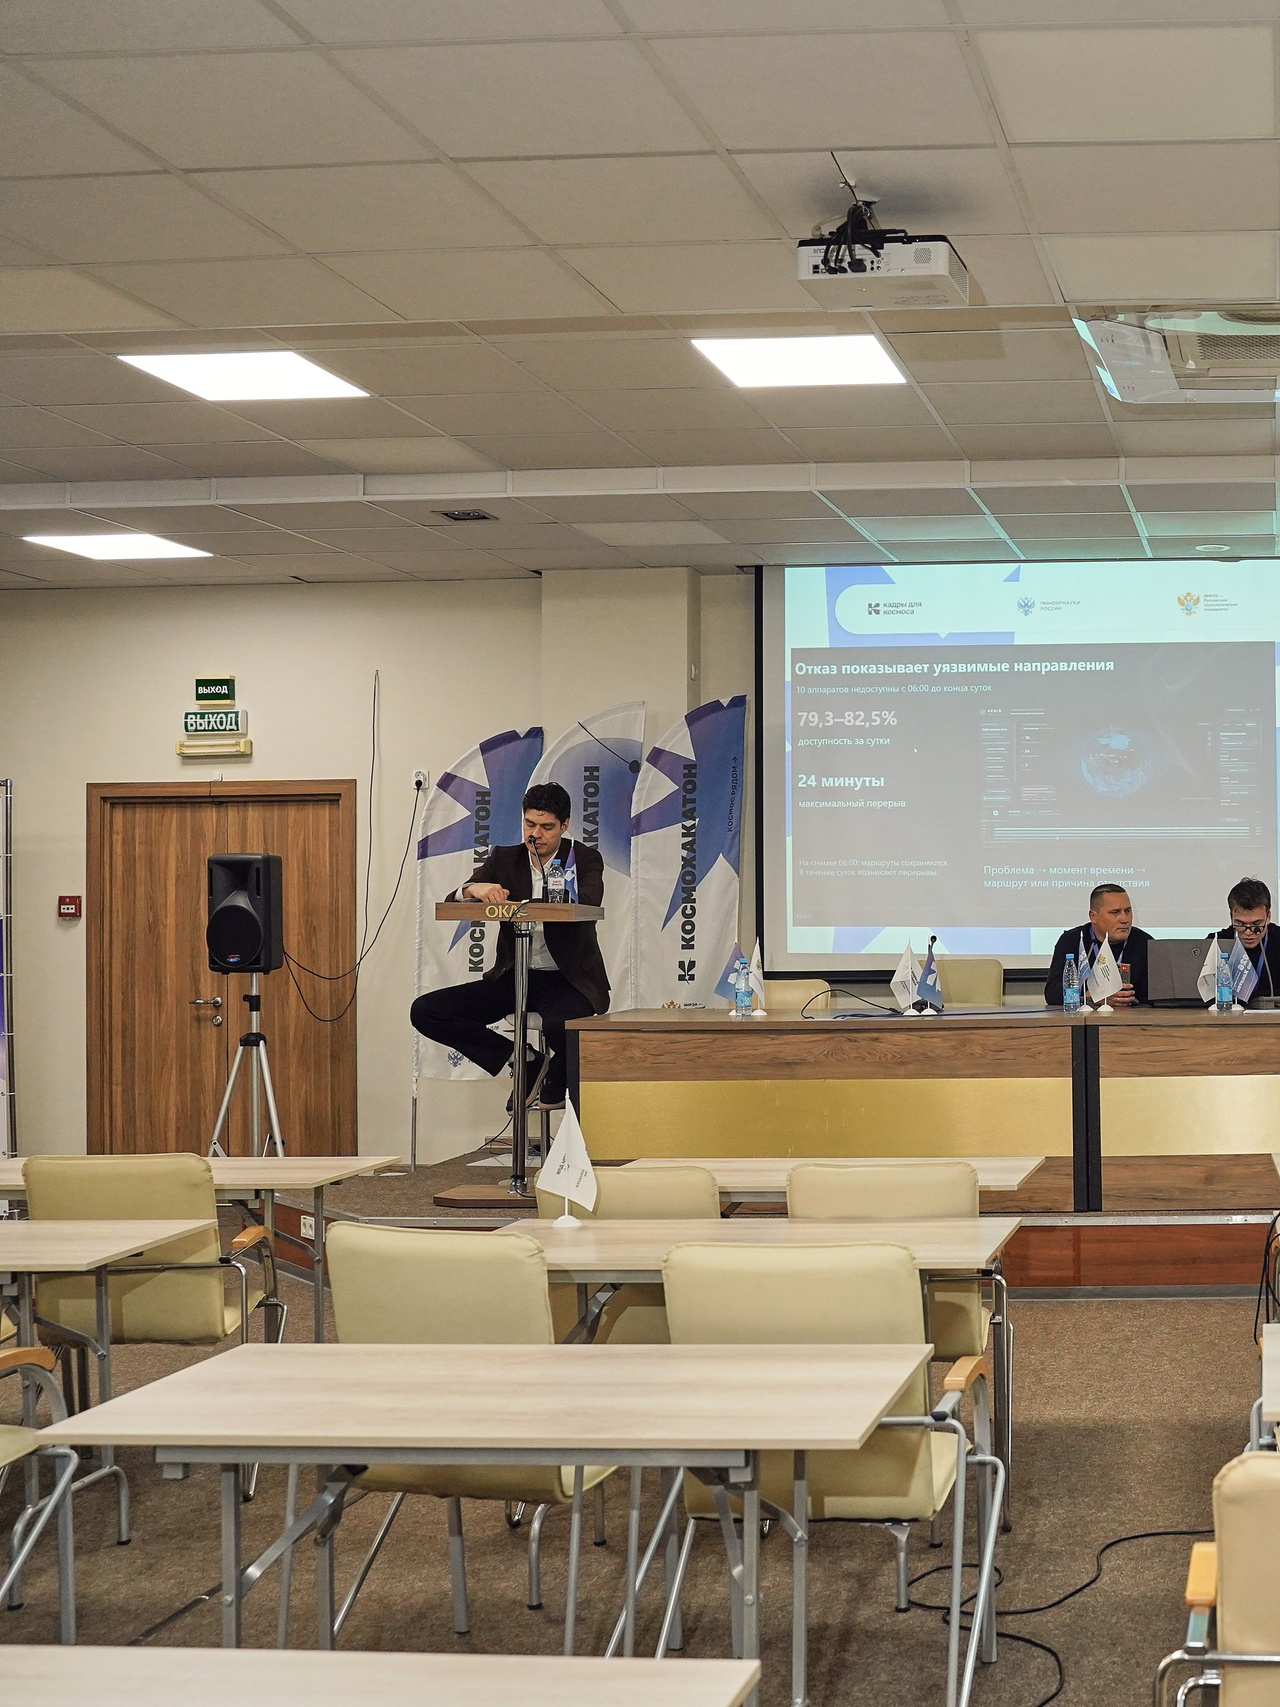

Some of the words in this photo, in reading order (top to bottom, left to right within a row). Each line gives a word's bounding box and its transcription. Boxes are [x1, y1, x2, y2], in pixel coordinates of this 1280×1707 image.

[883, 601, 906, 609] кадры
[908, 601, 922, 609] для
[795, 662, 837, 675] Отказ
[842, 663, 929, 674] показывает
[933, 661, 1010, 676] уязвимые
[1014, 660, 1115, 675] направления
[198, 686, 228, 694] ВЫХОД
[796, 686, 806, 694] 10
[808, 686, 849, 695] аппаратов
[851, 685, 899, 694] недоступны
[931, 685, 941, 694] до
[944, 685, 968, 693] конца
[970, 685, 992, 693] суток
[188, 713, 237, 730] ВЫХОД
[798, 711, 898, 728] 79,3–82,5%
[798, 738, 852, 747] доступность
[868, 738, 890, 746] сутки
[798, 775, 817, 788] 24
[821, 775, 885, 790] минуты
[799, 799, 864, 808] максимальный
[867, 800, 906, 809] перерыв
[681, 763, 697, 950] КОСМОХАКАТОН
[861, 860, 899, 868] маршруты
[836, 870, 856, 878] суток
[899, 869, 938, 878] перерывы.
[983, 865, 1034, 876] Проблема
[1049, 867, 1087, 875] момент
[1090, 867, 1134, 877] времени
[983, 879, 1027, 889] маршрут
[1052, 880, 1094, 889] причина
[1098, 879, 1150, 888] отсутствия
